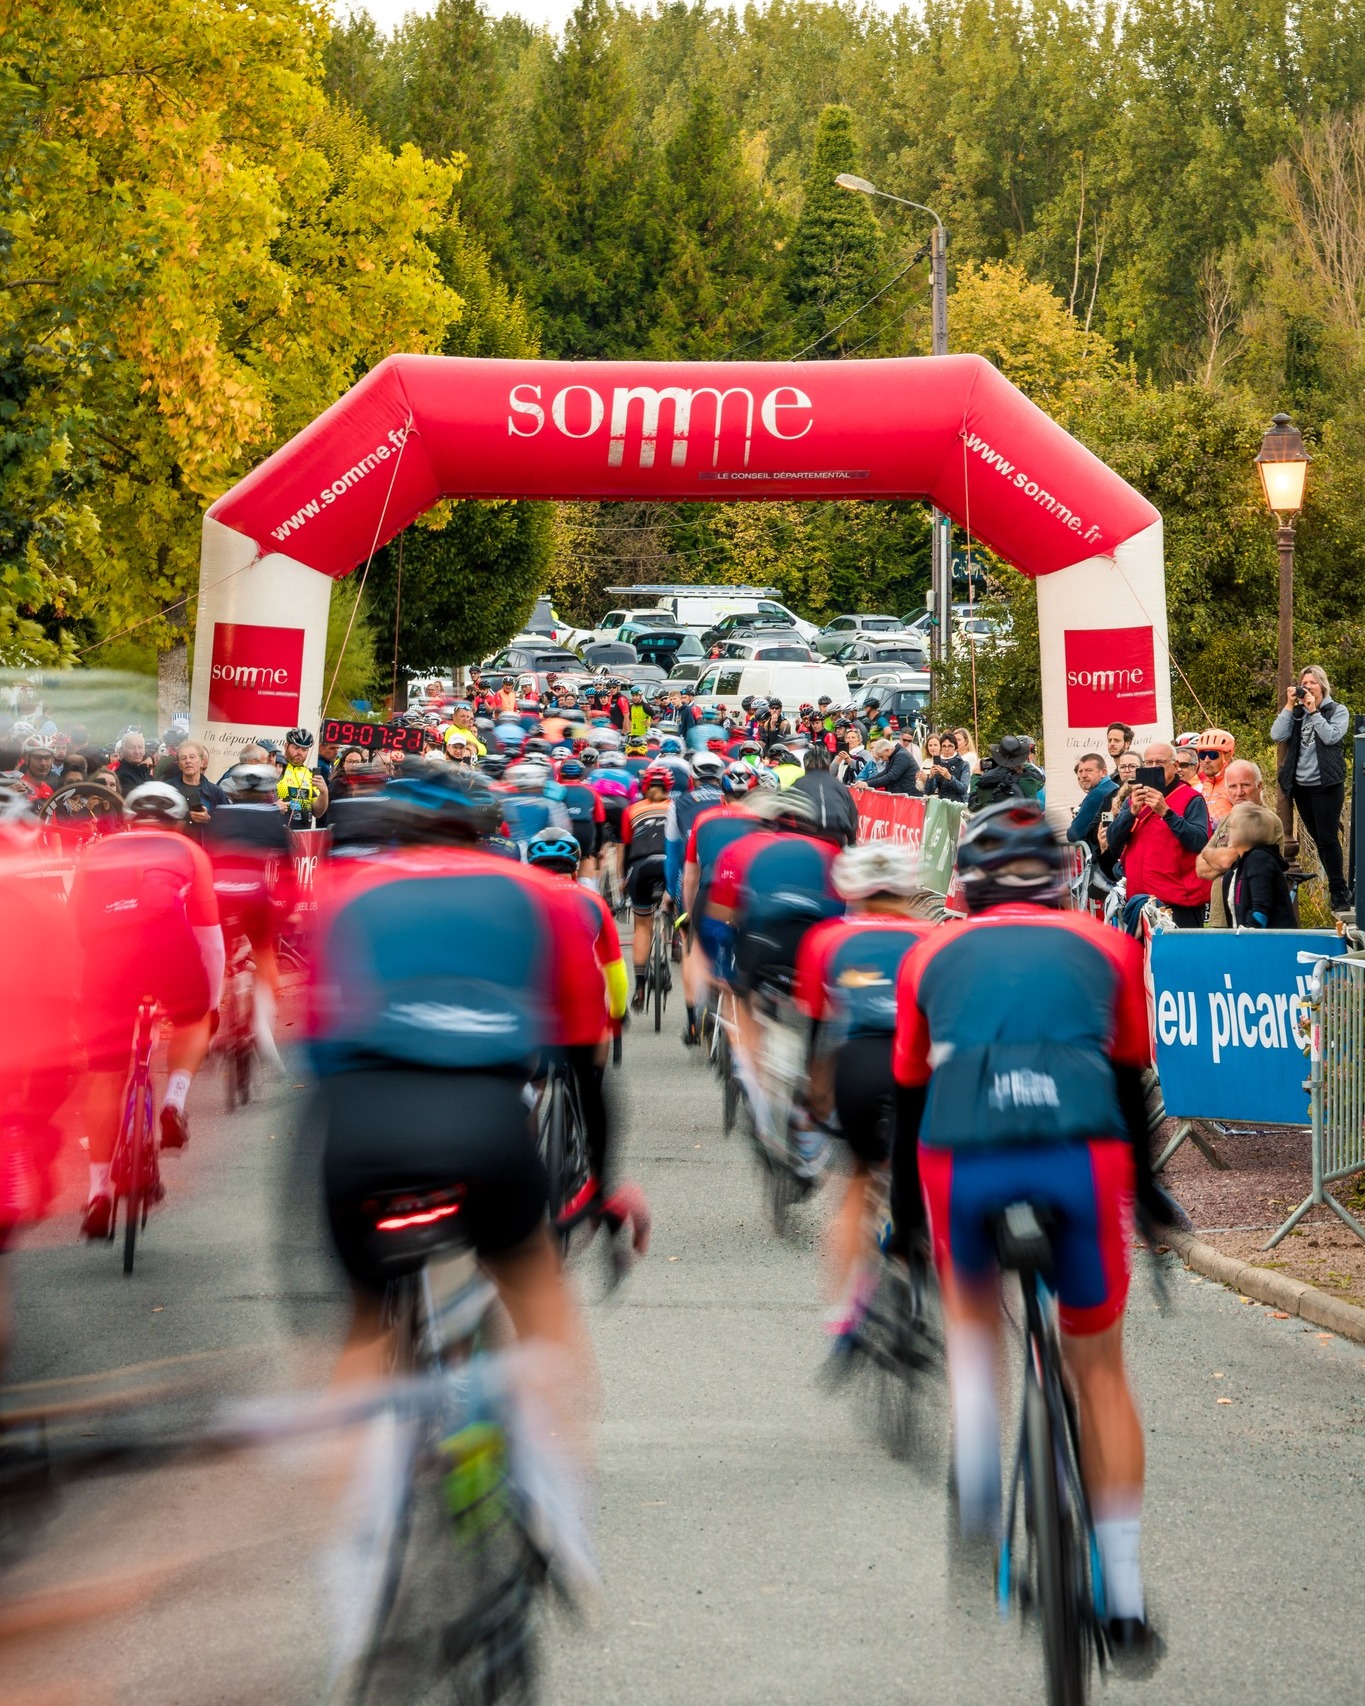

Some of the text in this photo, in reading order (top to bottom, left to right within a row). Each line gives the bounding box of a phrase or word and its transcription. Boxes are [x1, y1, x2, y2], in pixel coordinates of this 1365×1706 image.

[508, 384, 814, 468] somme
[270, 427, 408, 541] www.somme.fr
[773, 471, 851, 479] DÉPARTEMENTAL
[966, 433, 1103, 544] www.somme.fr
[212, 664, 288, 689] somme
[1067, 668, 1144, 691] somme
